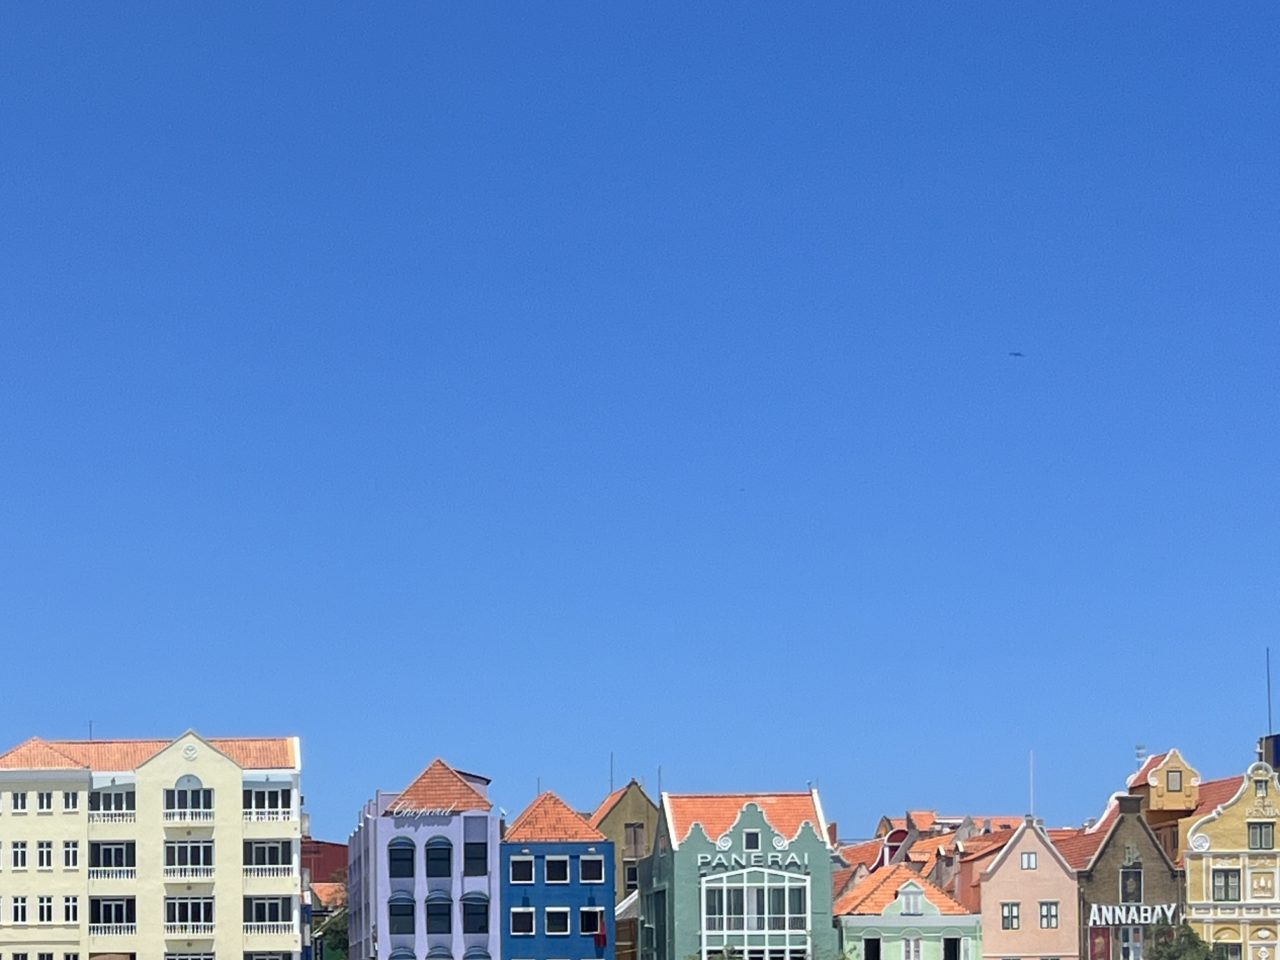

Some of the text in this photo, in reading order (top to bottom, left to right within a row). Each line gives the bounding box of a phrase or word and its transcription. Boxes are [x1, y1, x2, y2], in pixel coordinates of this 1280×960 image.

[393, 800, 457, 820] Chopard
[697, 852, 809, 866] PANERAI
[1089, 903, 1177, 927] ANNABAY
